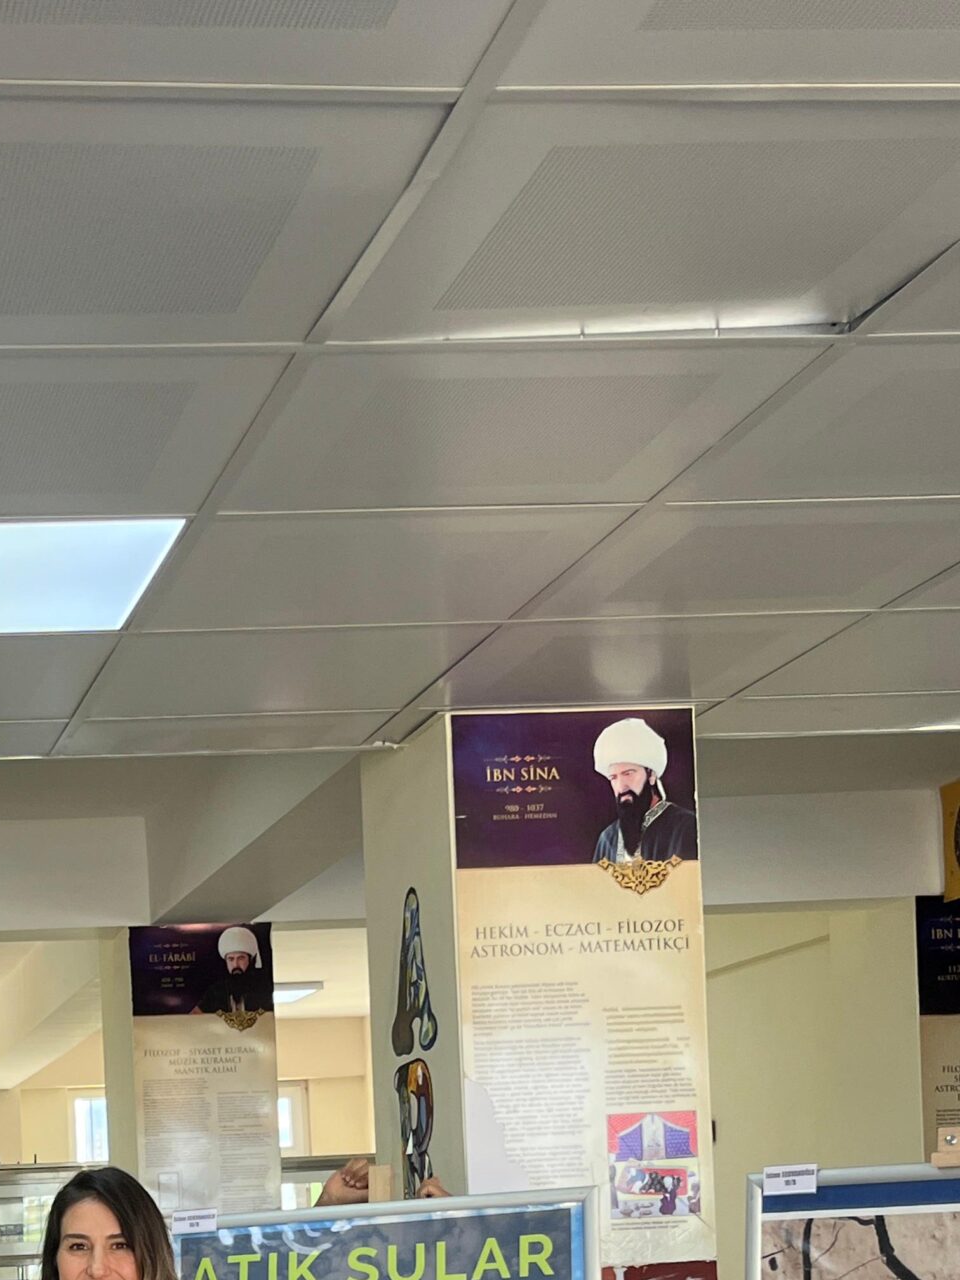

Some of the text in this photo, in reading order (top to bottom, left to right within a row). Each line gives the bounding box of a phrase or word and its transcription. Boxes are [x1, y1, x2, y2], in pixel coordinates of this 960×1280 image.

[486, 764, 560, 782] İBN SİNA
[475, 918, 685, 941] HEKİM ECZACI FİLOZOF
[470, 936, 690, 959] ASTRONOM MATEMATİKÇİ
